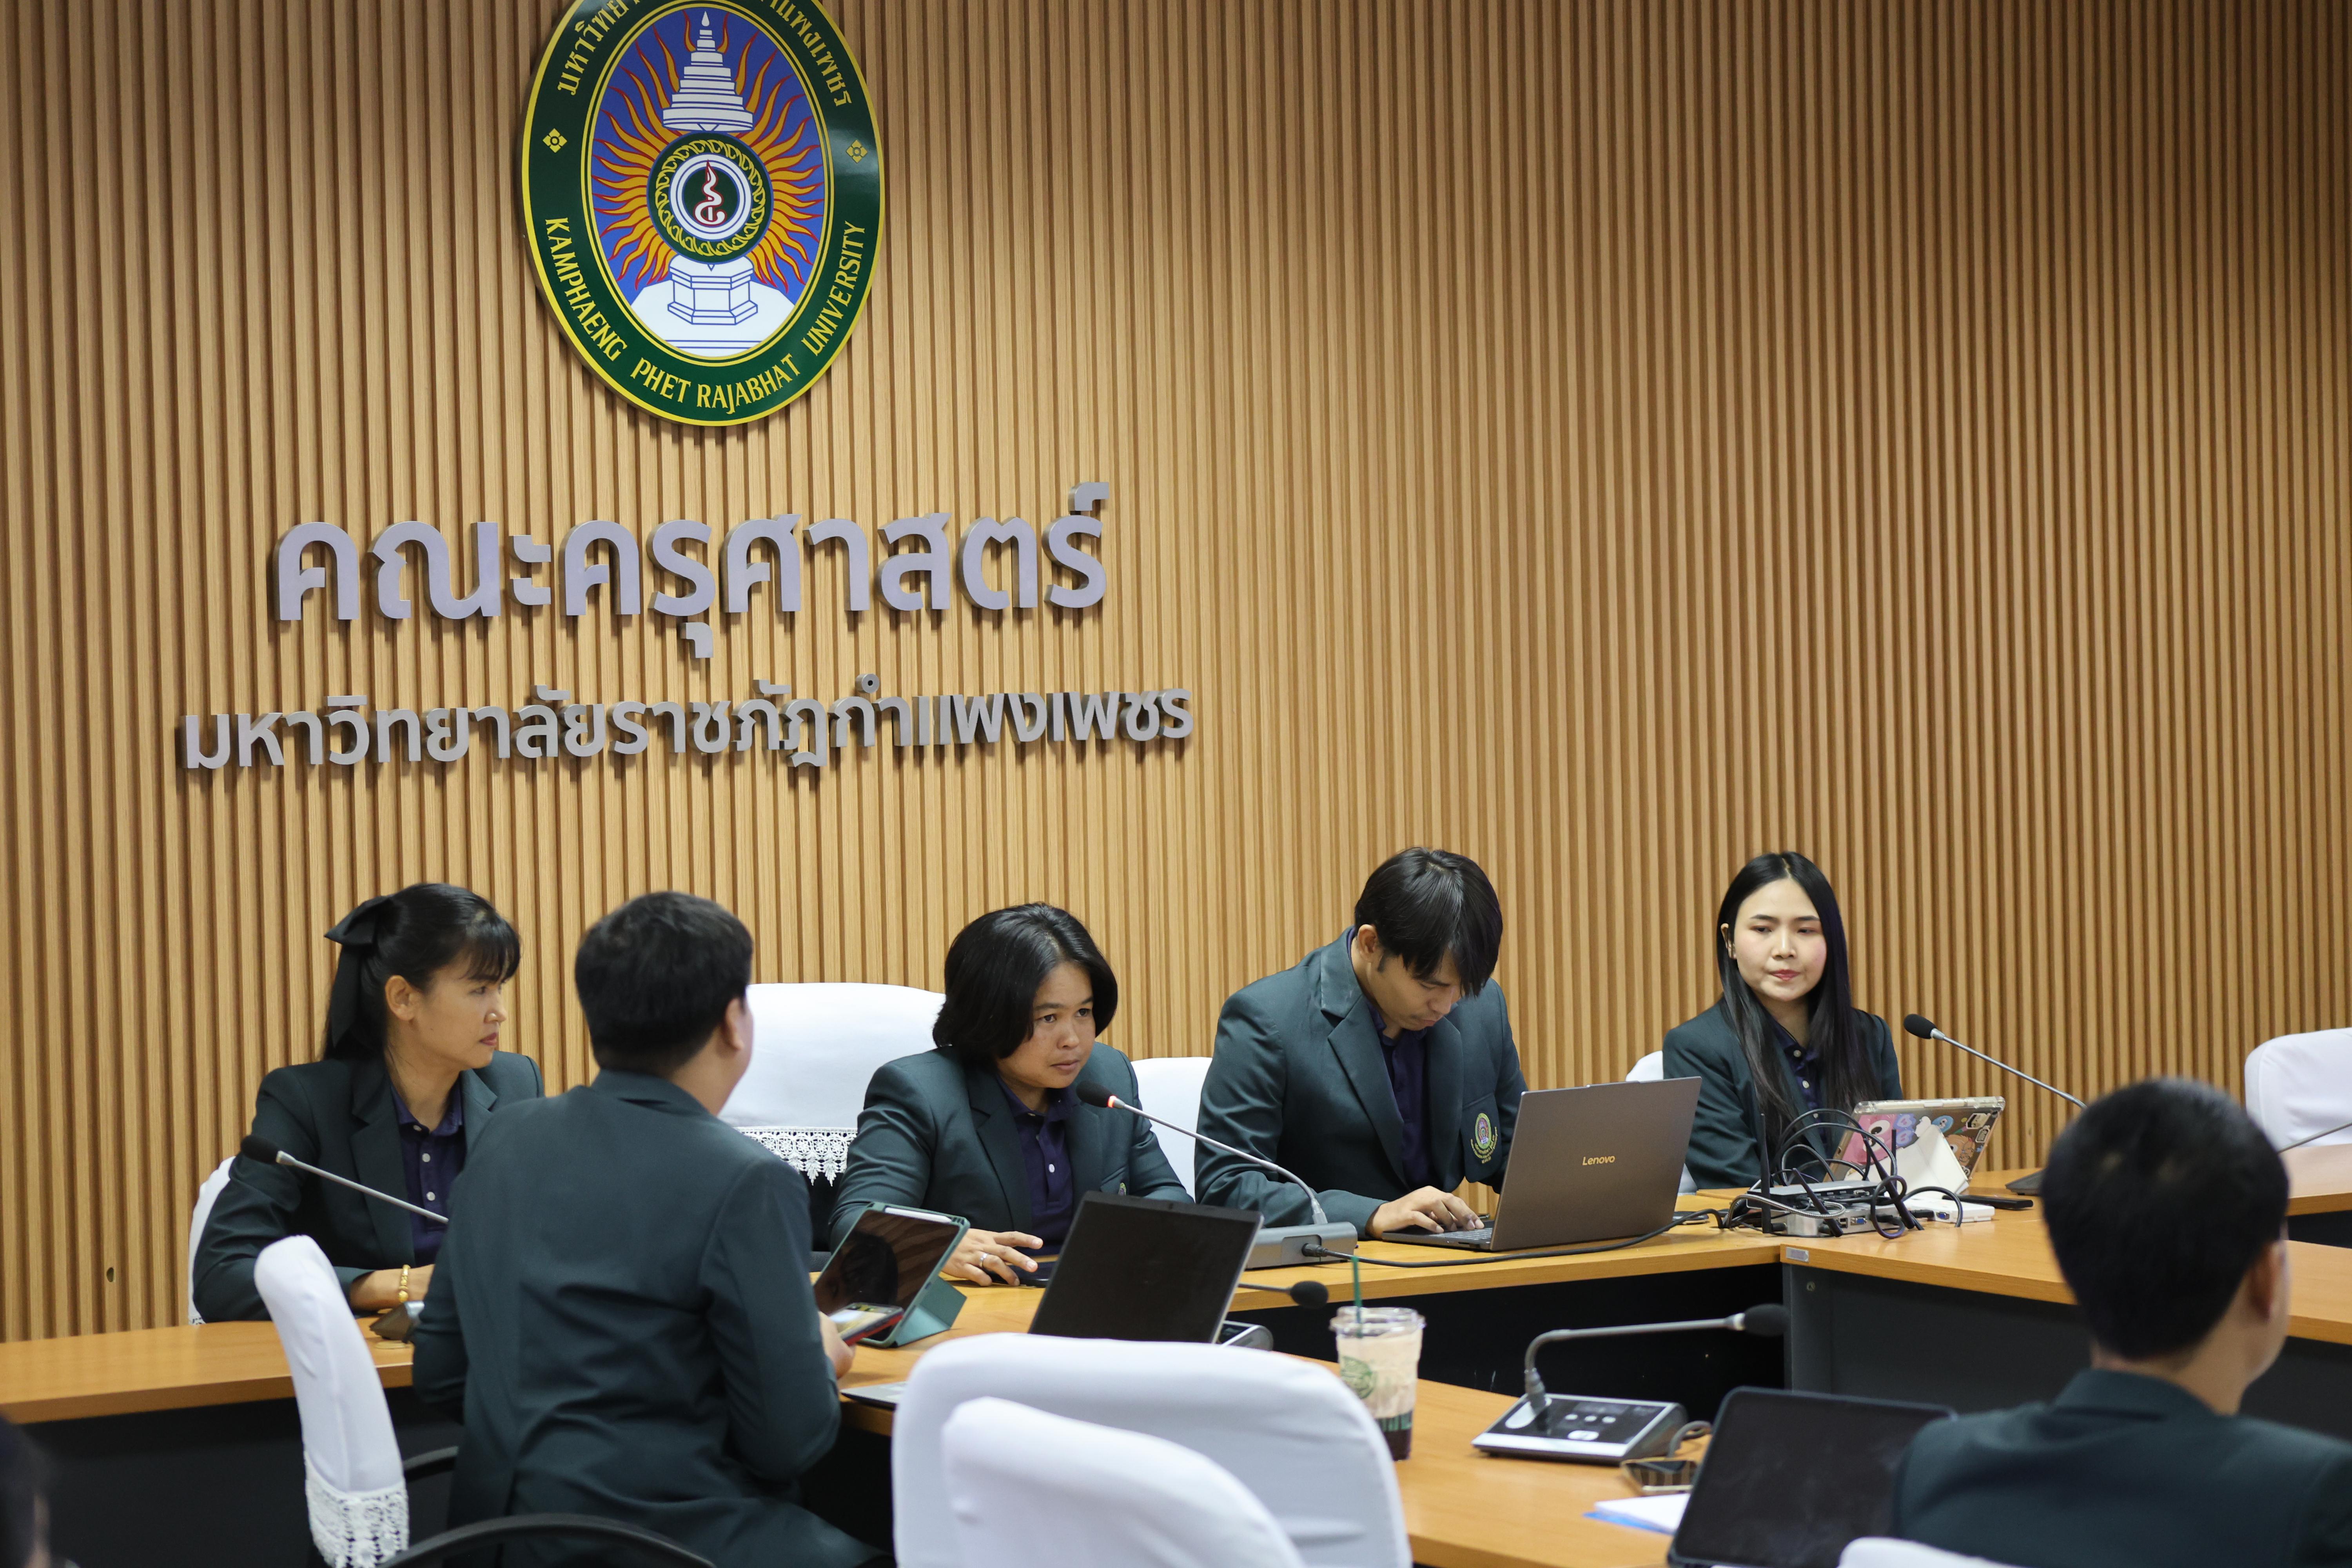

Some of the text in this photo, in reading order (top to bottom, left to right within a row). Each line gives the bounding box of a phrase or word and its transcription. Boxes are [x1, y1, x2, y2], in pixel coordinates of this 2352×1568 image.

[545, 217, 865, 414] KAMPHAENG PHET RAJABHAT UNIVERSITY
[273, 483, 1109, 658] คณะครุศาสตร์
[1582, 1156, 1615, 1165] Lenovo
